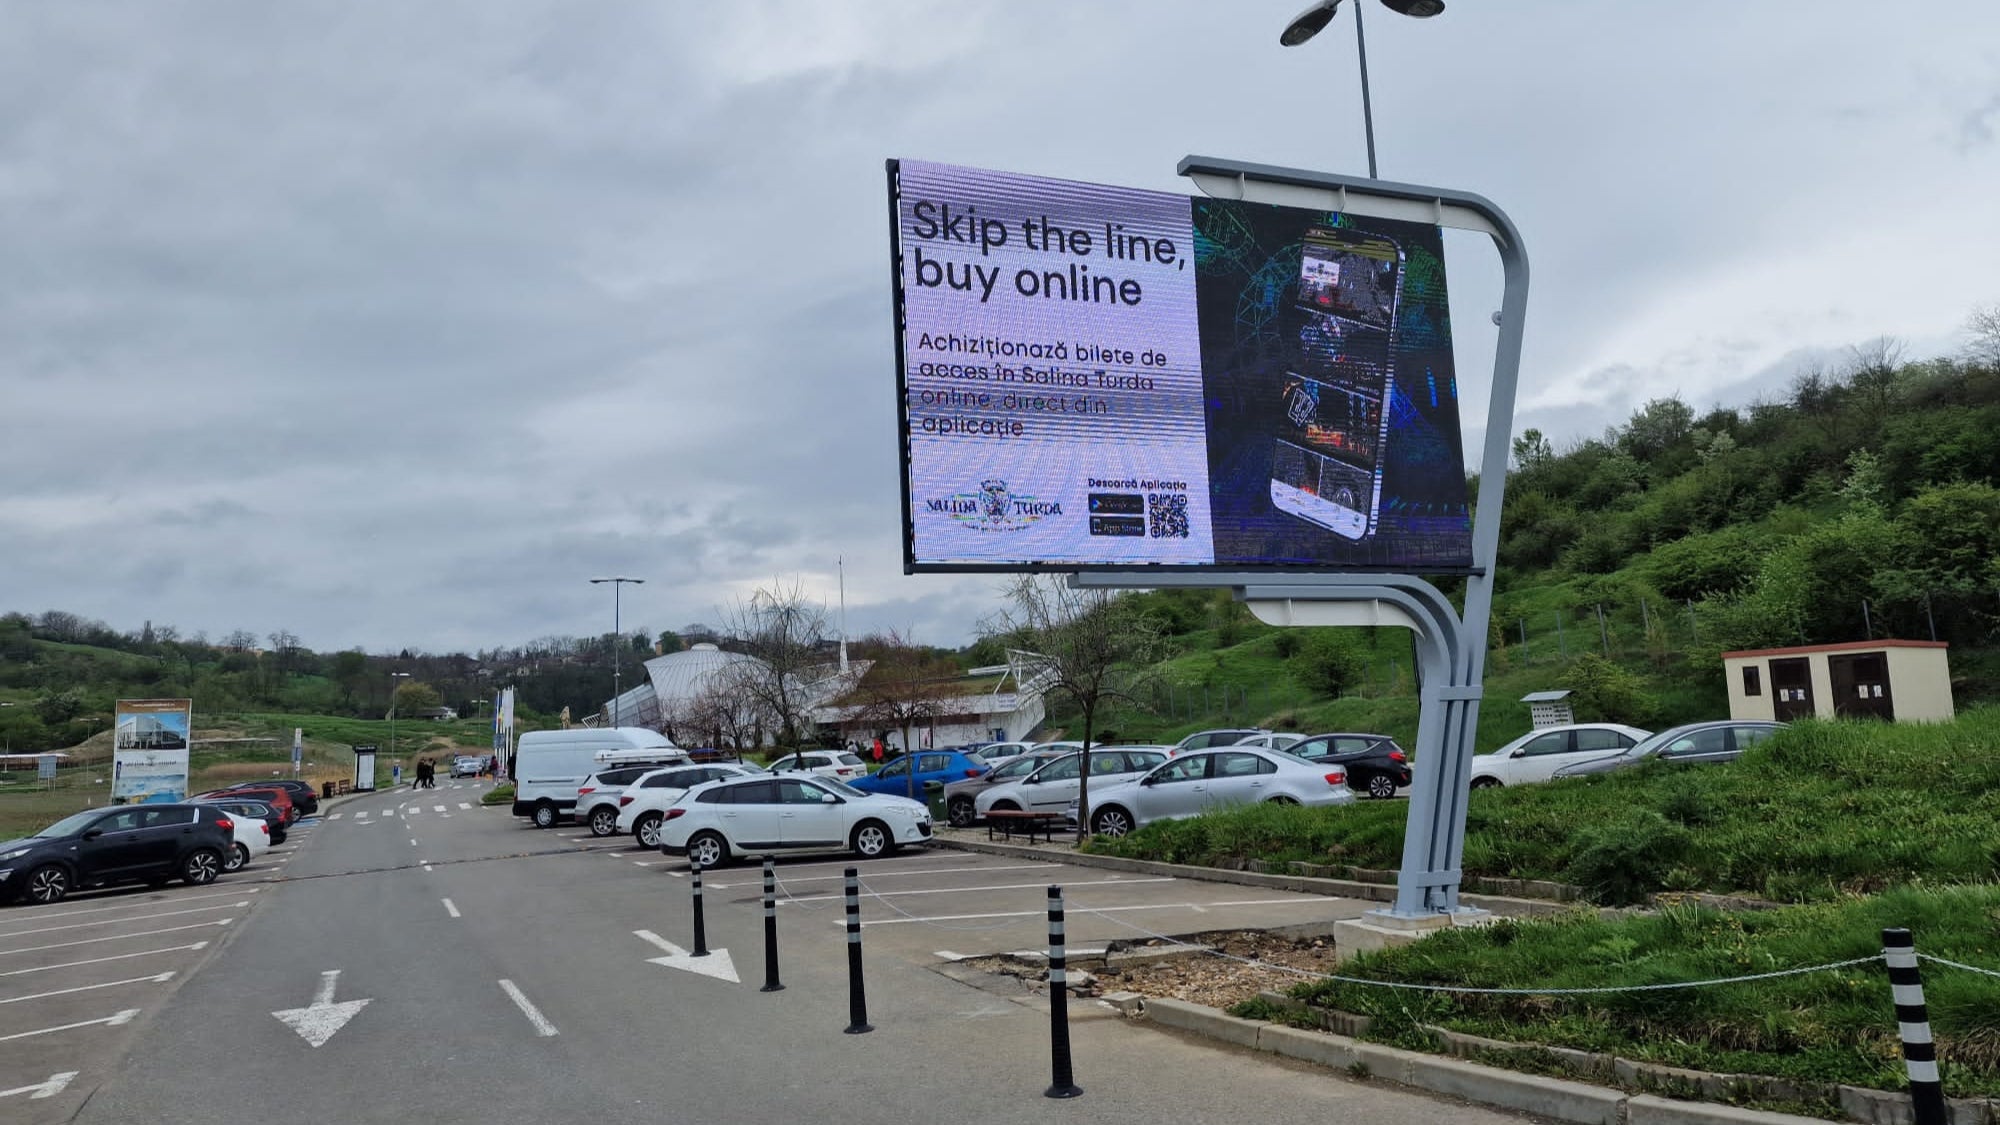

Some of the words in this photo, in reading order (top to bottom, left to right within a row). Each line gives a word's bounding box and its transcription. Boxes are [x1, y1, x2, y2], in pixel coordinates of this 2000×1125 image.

[912, 200, 1008, 256] Skip
[1021, 215, 1092, 256] the
[1105, 222, 1185, 271] line,
[914, 247, 1000, 303] buy
[1014, 263, 1142, 306] online
[1075, 343, 1134, 363] bilete
[1140, 348, 1167, 367] de
[919, 362, 988, 380] acces
[1022, 366, 1088, 386] Salina
[1095, 370, 1154, 391] Turda
[920, 387, 997, 409] online,
[1003, 392, 1066, 412] direct
[1074, 395, 1107, 414] din
